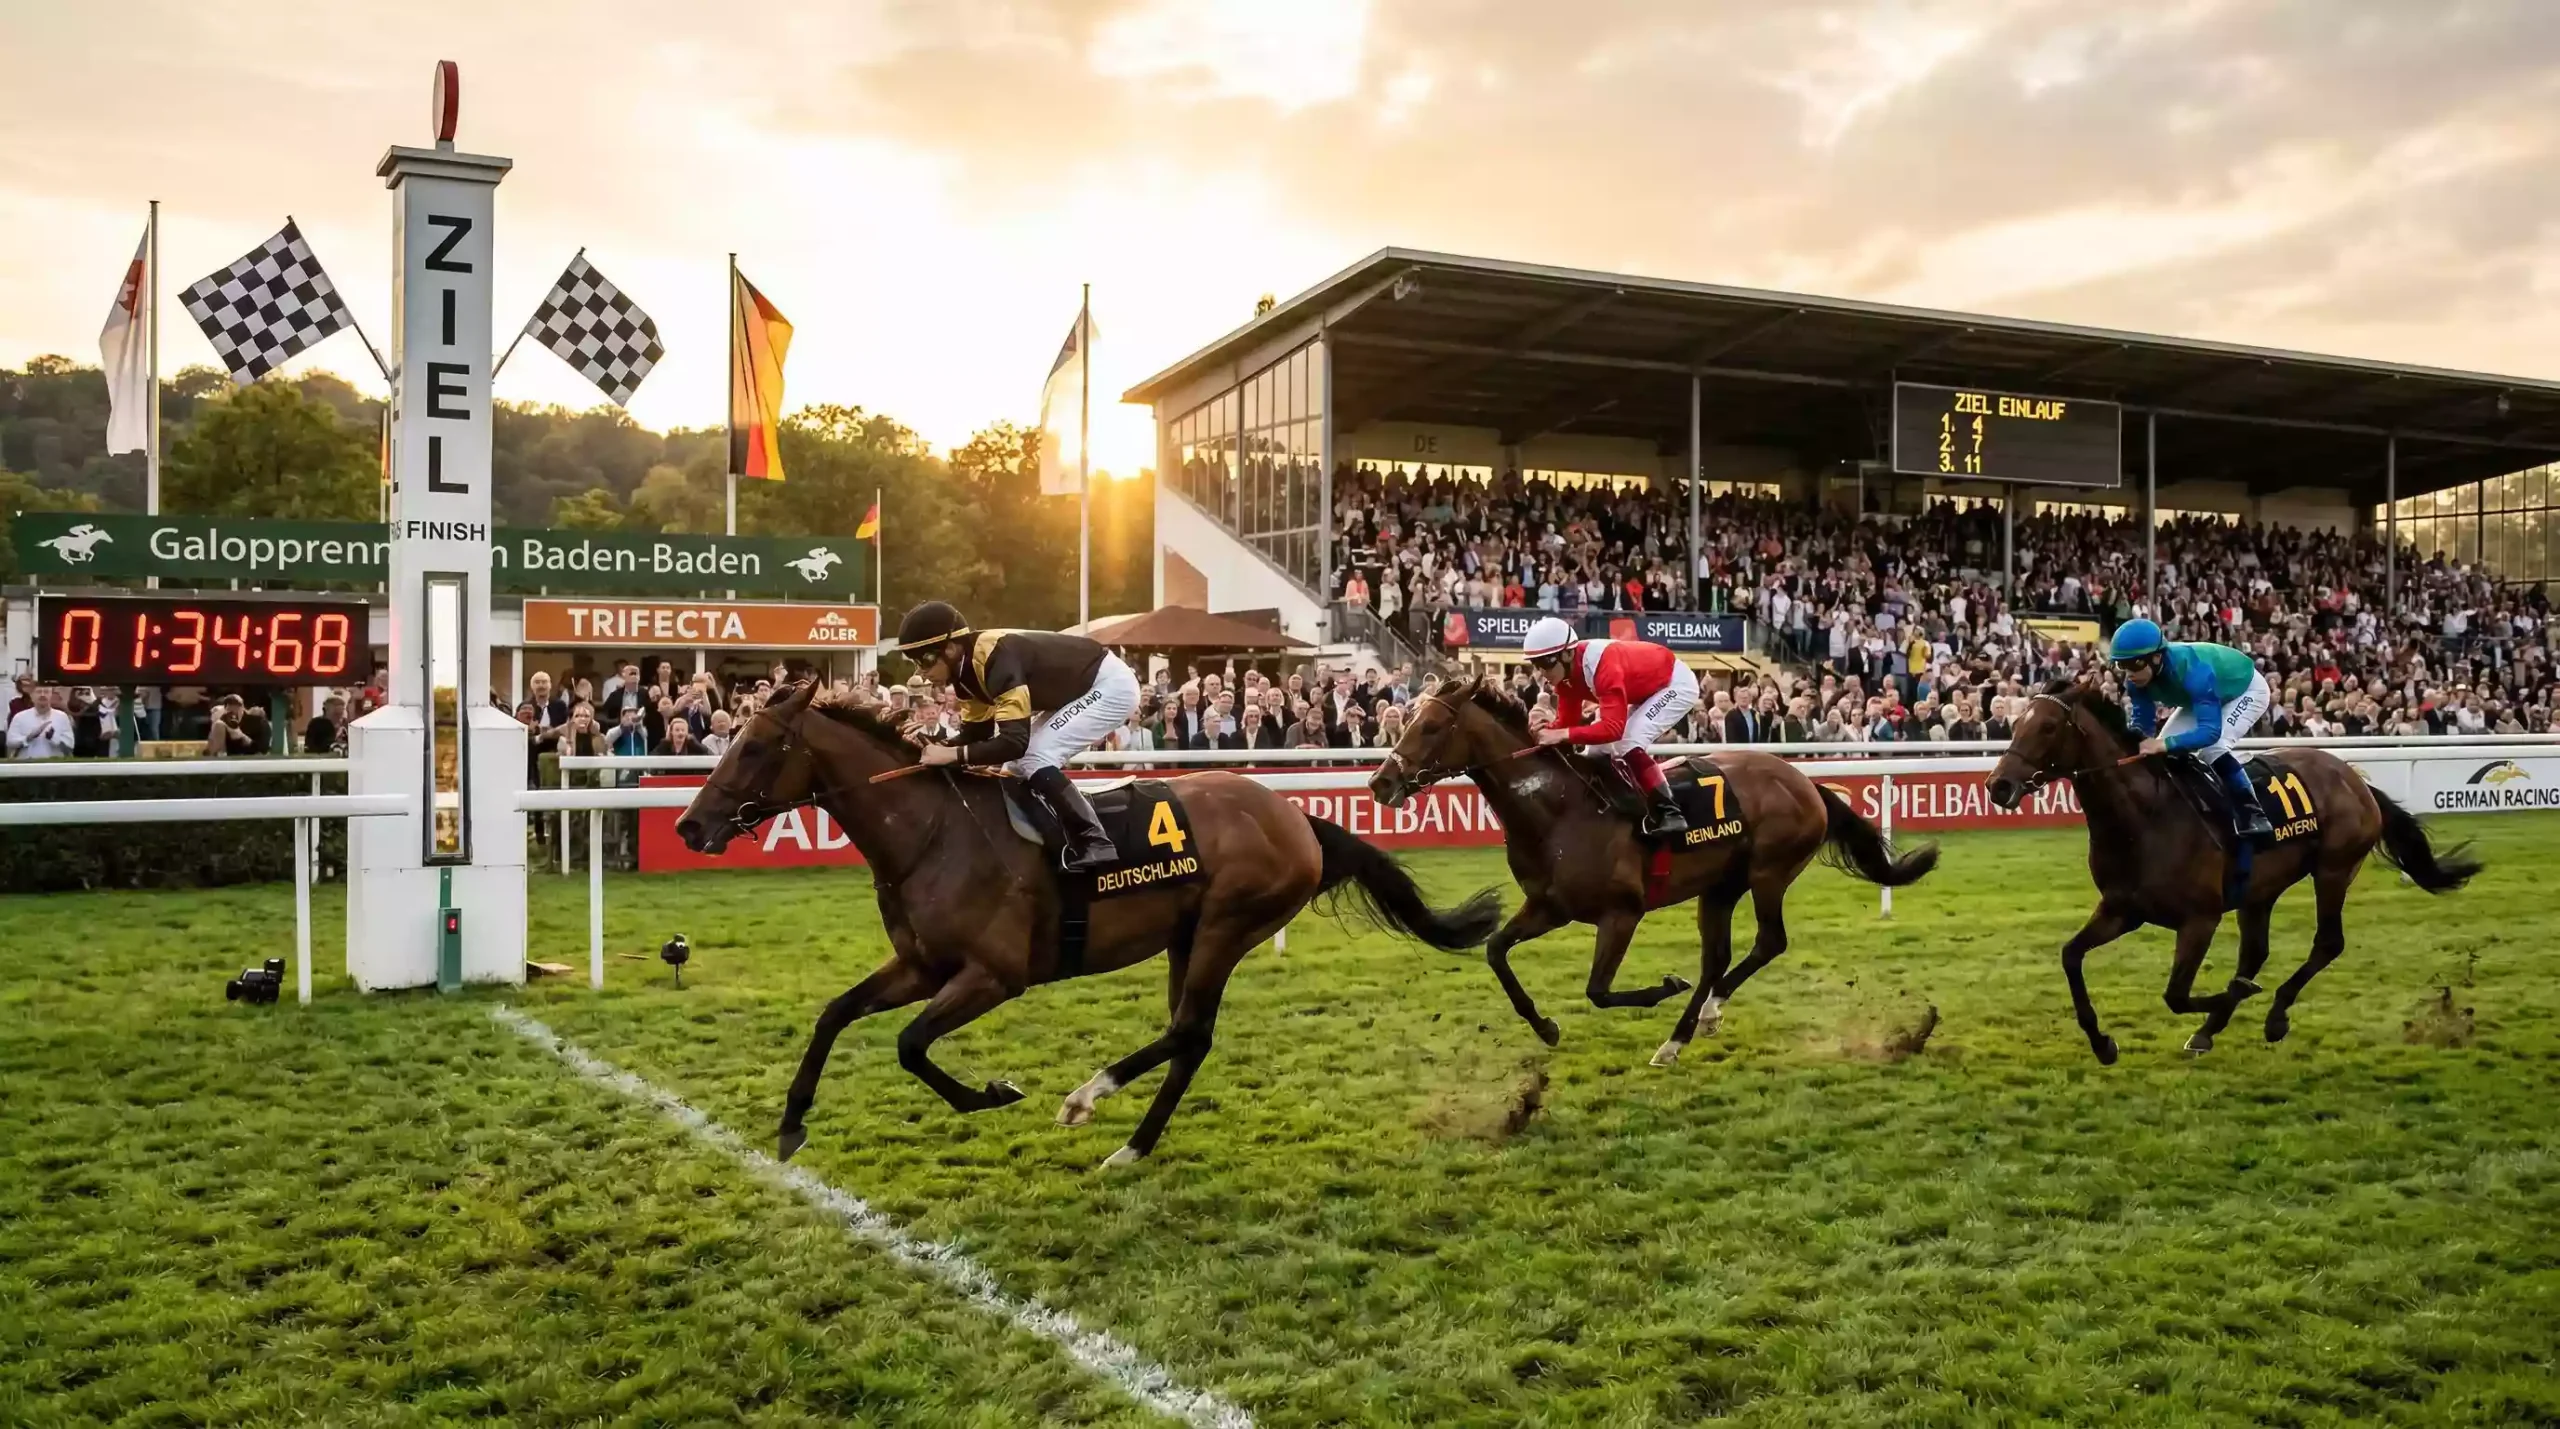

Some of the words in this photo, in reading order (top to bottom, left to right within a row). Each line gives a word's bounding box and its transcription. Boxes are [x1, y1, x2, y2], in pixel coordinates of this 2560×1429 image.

[425, 214, 473, 494] ZIEL
[1955, 393, 1993, 415] ZIEL
[1999, 397, 2066, 420] EINLAUF
[1972, 415, 1983, 434] 4
[1414, 434, 1437, 454] DE
[1940, 432, 1955, 452] 2.
[1972, 434, 1983, 453] 7
[1940, 452, 1955, 472] 3.
[1964, 454, 1981, 474] 11
[407, 521, 485, 542] FINISH
[523, 539, 761, 576] Baden-Baden
[567, 608, 747, 640] TRIFECTA
[808, 626, 859, 641] ADLER
[1647, 622, 1721, 638] SPIELBANK
[60, 609, 348, 673] 01:34:68
[1697, 775, 1725, 819] 7
[2267, 772, 2313, 819] 11
[2434, 789, 2500, 809] GERMAN
[2504, 788, 2560, 807] RACING
[1148, 801, 1186, 853] 4
[1685, 820, 1742, 845] REINLAND
[2275, 817, 2318, 842] BAYERN
[1098, 857, 1198, 892] DEUTSCHLAND
